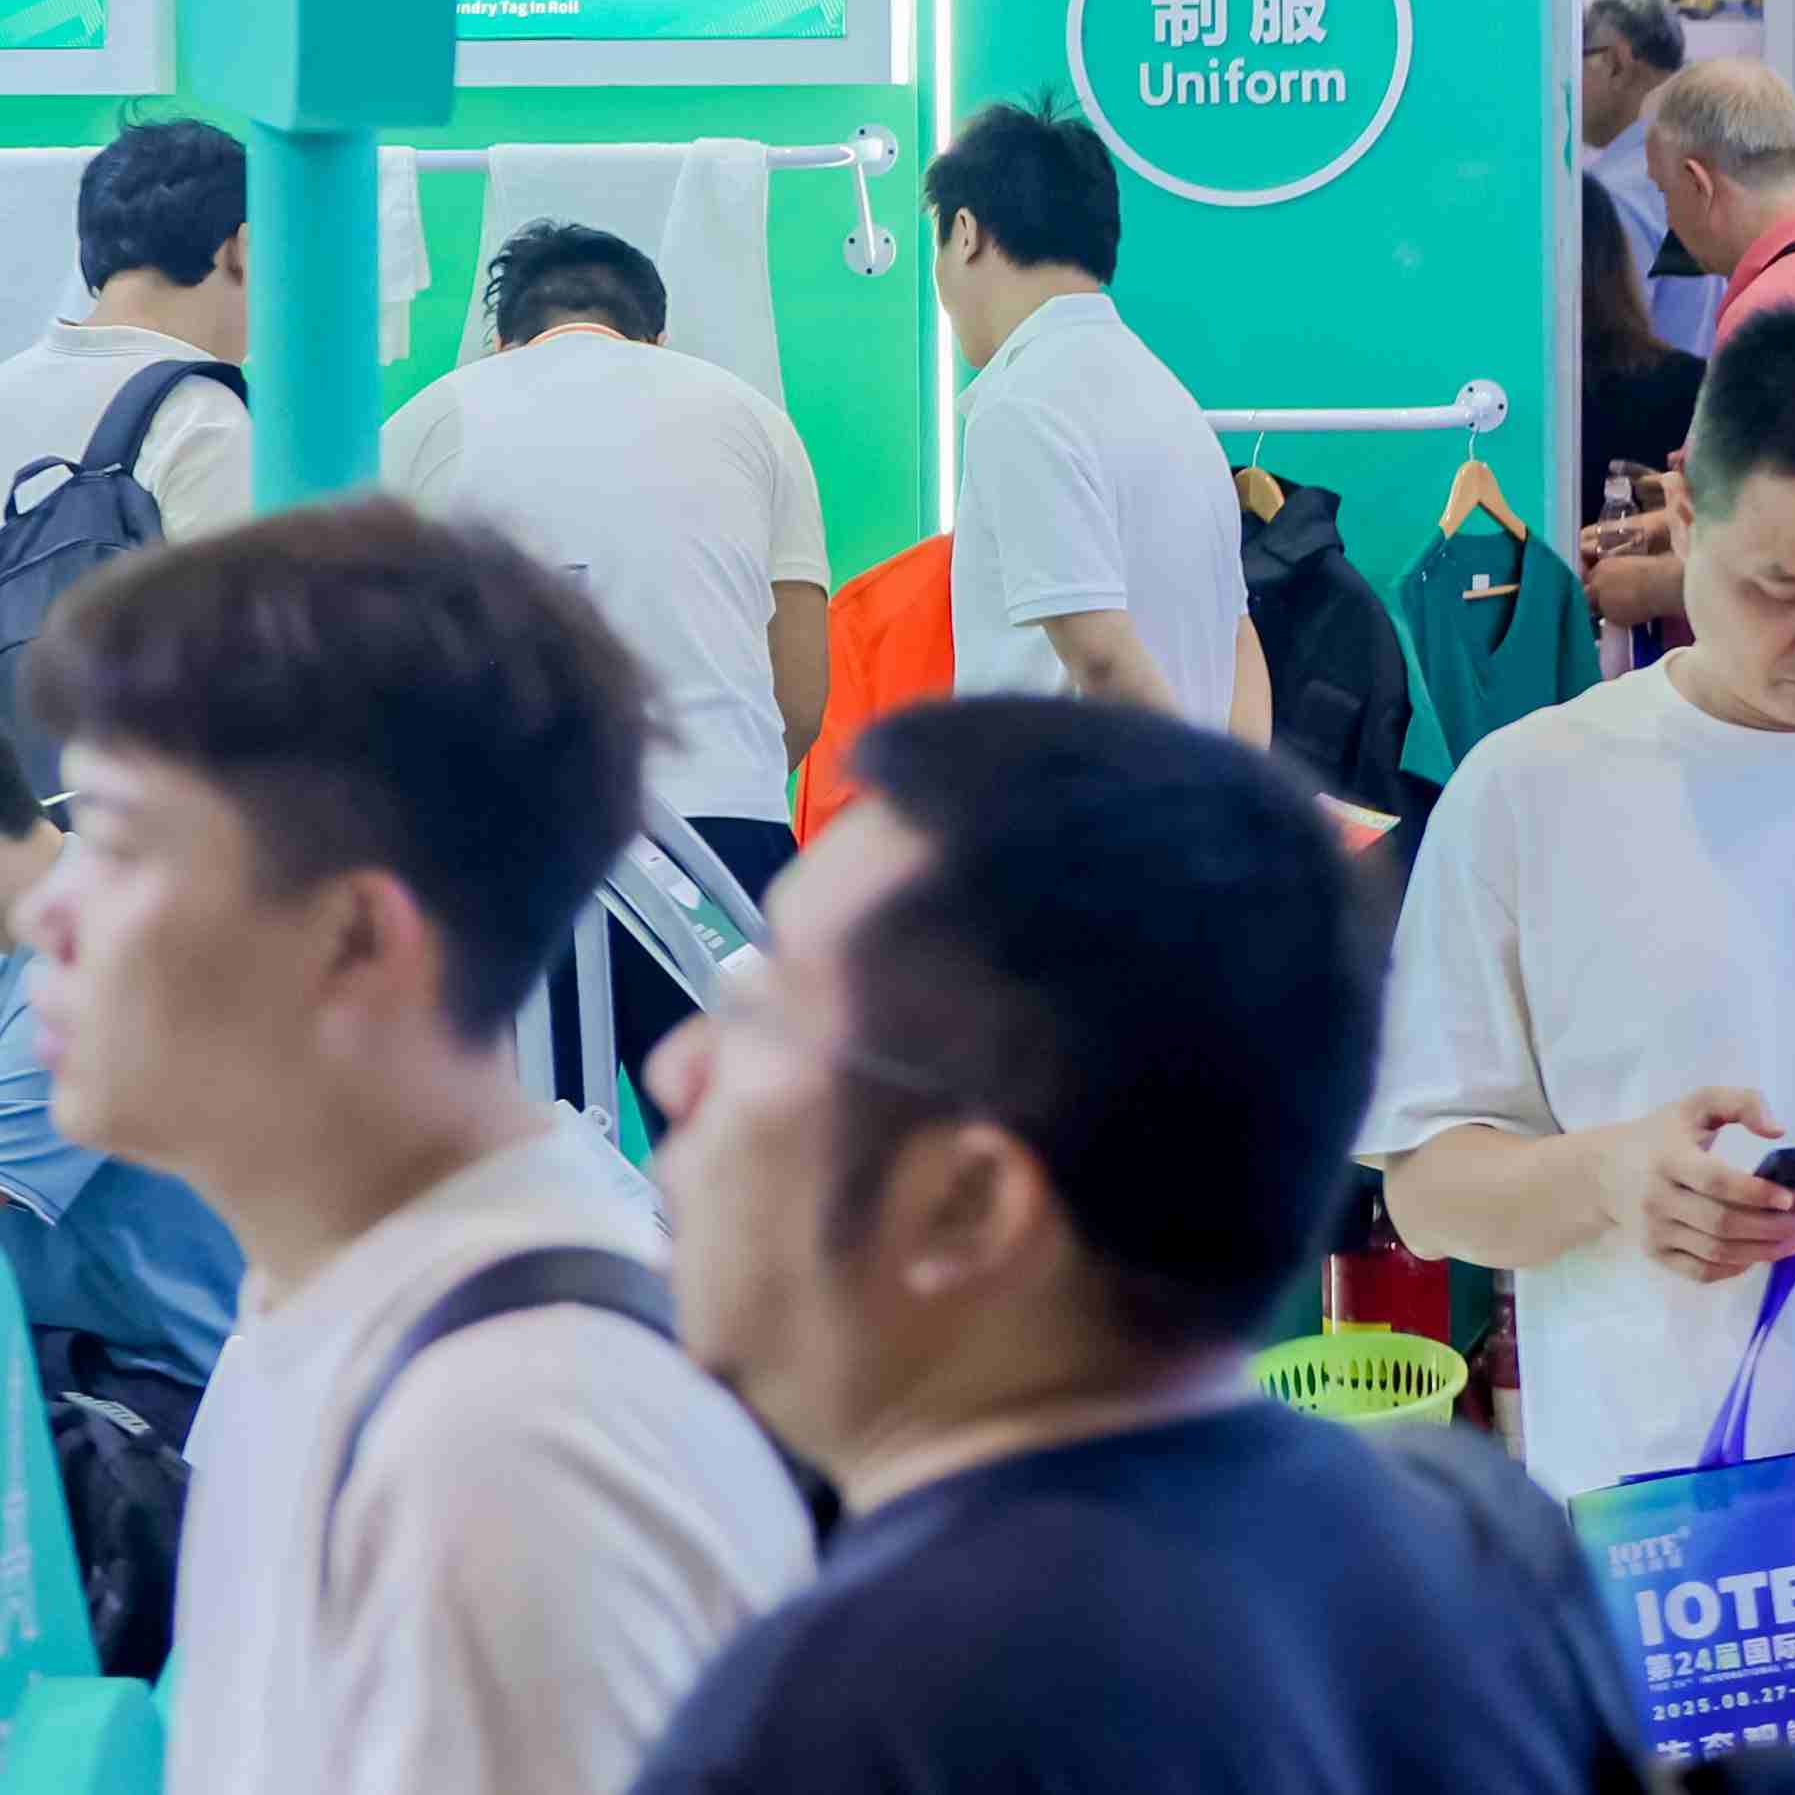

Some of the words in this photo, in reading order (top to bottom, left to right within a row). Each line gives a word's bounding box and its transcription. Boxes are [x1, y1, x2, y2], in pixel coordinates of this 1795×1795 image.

[501, 0, 529, 18] Tag
[547, 0, 580, 15] Roll
[1138, 56, 1347, 108] Uniform
